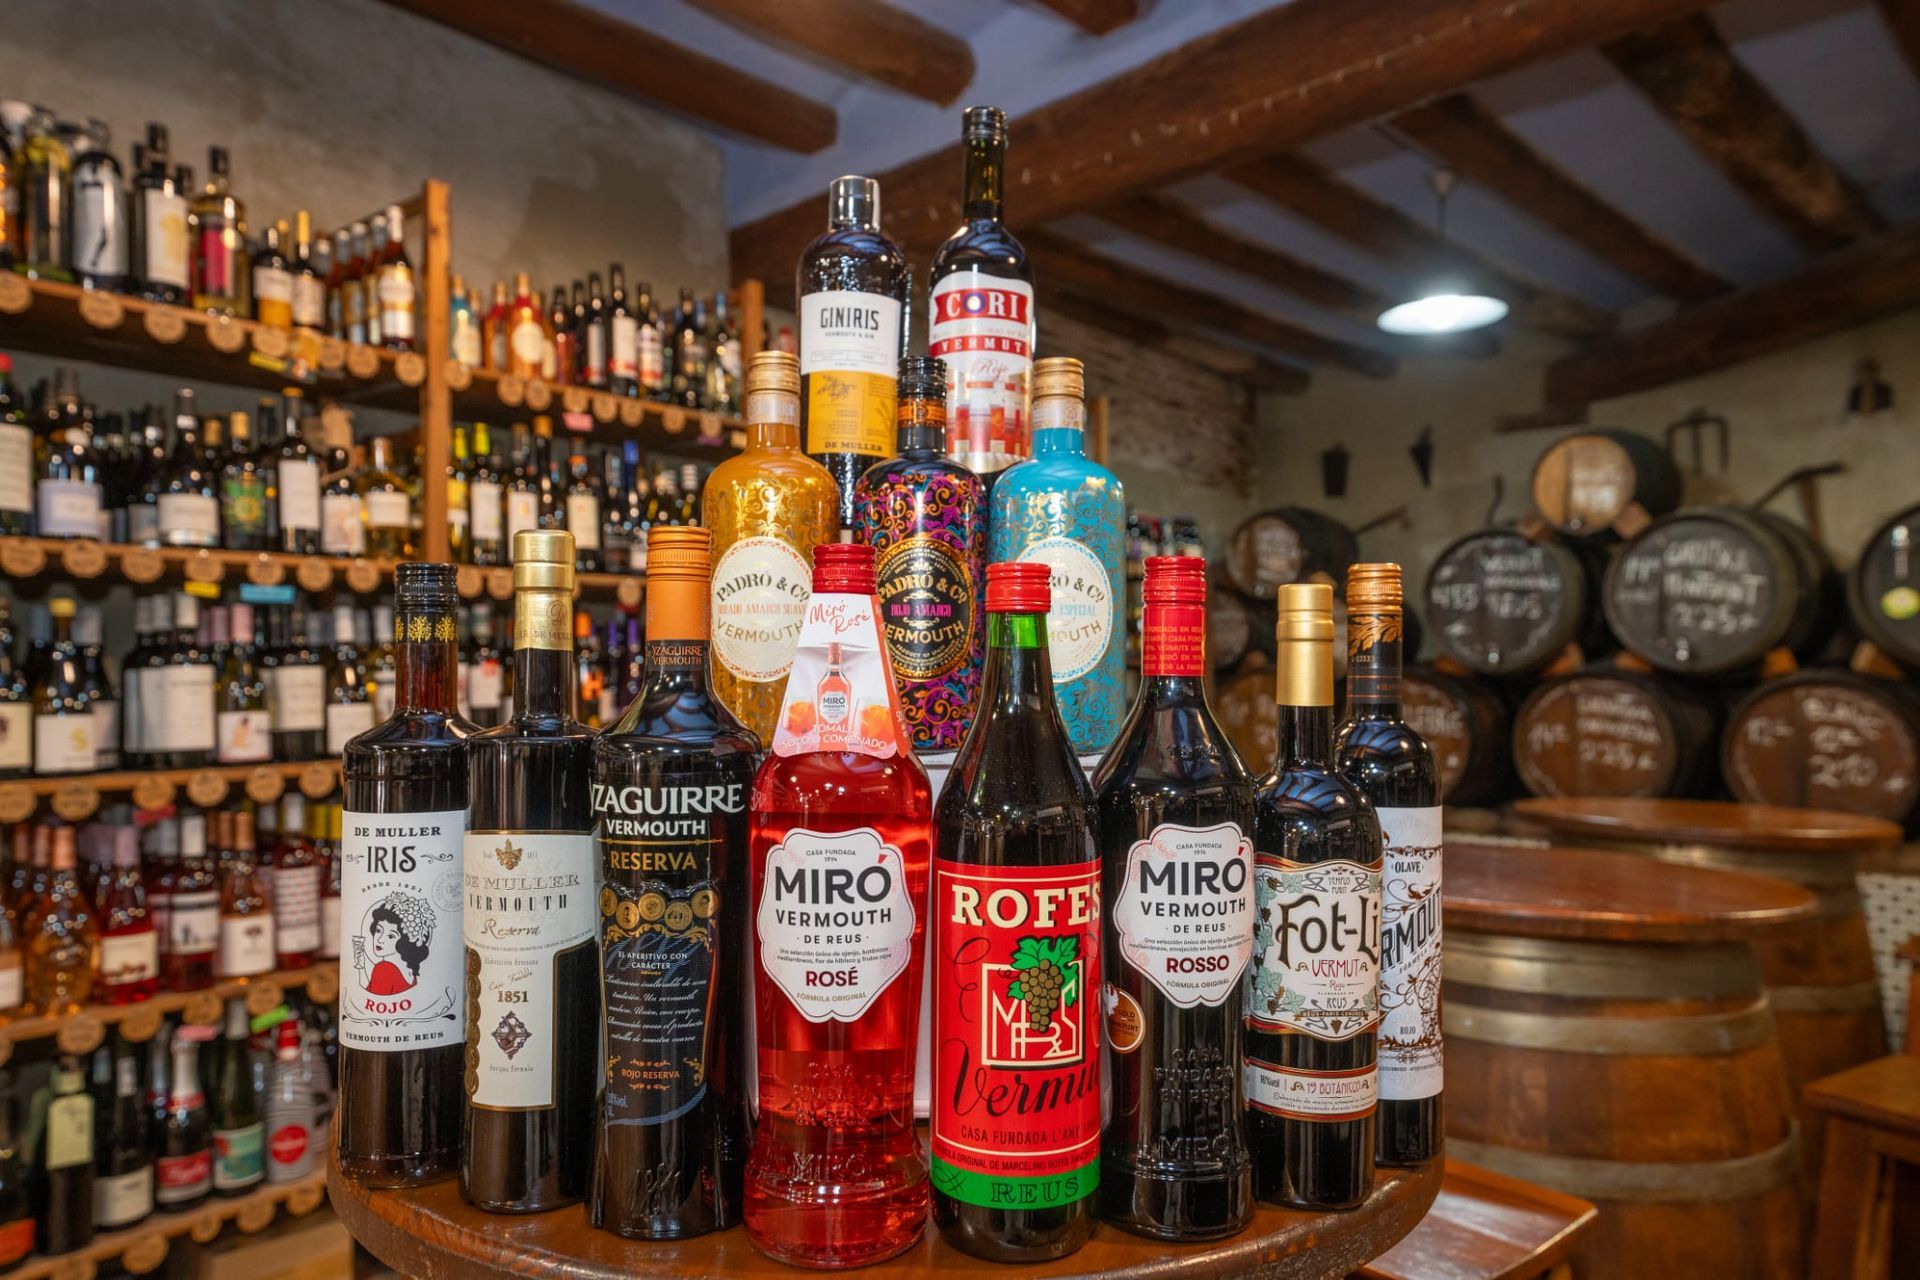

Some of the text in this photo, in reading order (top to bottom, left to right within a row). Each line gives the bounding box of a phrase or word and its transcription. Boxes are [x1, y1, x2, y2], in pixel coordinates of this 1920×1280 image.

[946, 292, 1019, 318] CORI
[820, 307, 880, 331] GINIRIS
[941, 337, 1022, 353] VERMUT
[824, 441, 883, 451] DE MULLER
[716, 570, 772, 602] PADRÓ
[776, 577, 788, 591] &
[878, 571, 934, 604] PADRÓ
[936, 577, 948, 593] &
[1074, 577, 1084, 592] &
[809, 600, 848, 625] Miró
[829, 610, 870, 635] Rosé
[884, 620, 965, 644] ERMOUTH
[652, 656, 702, 665] VERMOUTH
[823, 696, 845, 704] MIRÓ
[823, 734, 887, 749] COMBINADO
[354, 826, 441, 838] DE MULLER
[606, 819, 706, 836] VERMOUTH
[367, 846, 416, 873] IRIS
[610, 852, 697, 870] RESERVA
[1395, 861, 1421, 873] OLAVE
[775, 854, 892, 904] MIRÓ
[1139, 846, 1247, 896] MIRÓ
[465, 872, 581, 891] DE MULLER
[469, 894, 567, 911] VERMOUTH
[1140, 897, 1246, 918] VERMOUTH
[775, 907, 892, 928] VERMOUTH
[480, 918, 541, 940] Reserva
[1173, 923, 1226, 934] DE REUS
[804, 934, 862, 944] DE REUS
[627, 952, 668, 960] APERITIVO
[1166, 955, 1230, 973] ROSSO
[806, 966, 858, 987] ROSÉ
[1311, 959, 1360, 978] VERMUT
[1201, 979, 1230, 989] ORIGINAL
[497, 991, 529, 1003] 1851
[832, 992, 866, 1002] ORIGINAL
[1326, 997, 1347, 1009] REUS
[364, 998, 411, 1014] ROJO
[345, 1031, 443, 1043] VERMOUTH DE REUS
[1400, 1026, 1416, 1035] ROJO
[621, 1068, 680, 1079] ROJO RESERVA
[1307, 1080, 1360, 1095] 19 BOTÁNICOS
[961, 1125, 988, 1142] CASA
[993, 1130, 1047, 1145] FUNDADA
[989, 1160, 999, 1169] DE
[1002, 1160, 1046, 1171] MARCELINO
[991, 1175, 1080, 1204] REUS
